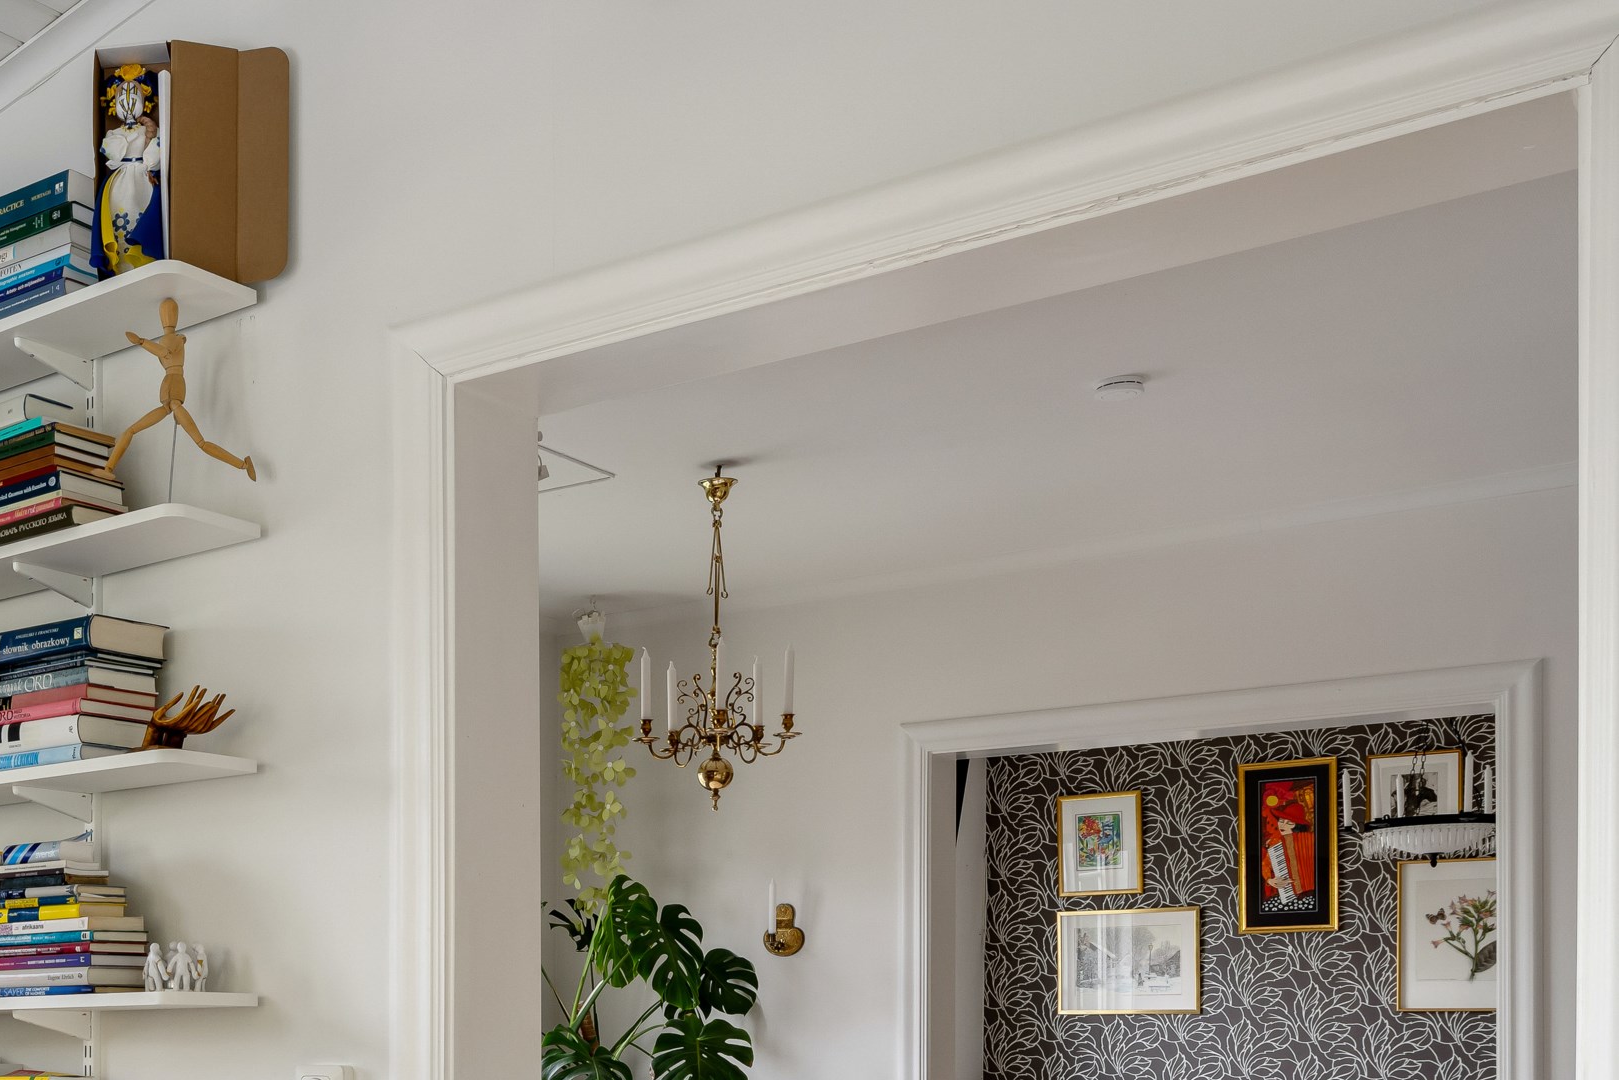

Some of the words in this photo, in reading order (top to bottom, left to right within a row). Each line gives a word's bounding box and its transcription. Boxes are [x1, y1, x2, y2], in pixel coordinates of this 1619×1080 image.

[3, 643, 29, 656] słownik
[31, 637, 70, 650] obrazkowy
[24, 673, 53, 693] ORD
[21, 922, 44, 931] afrikaans
